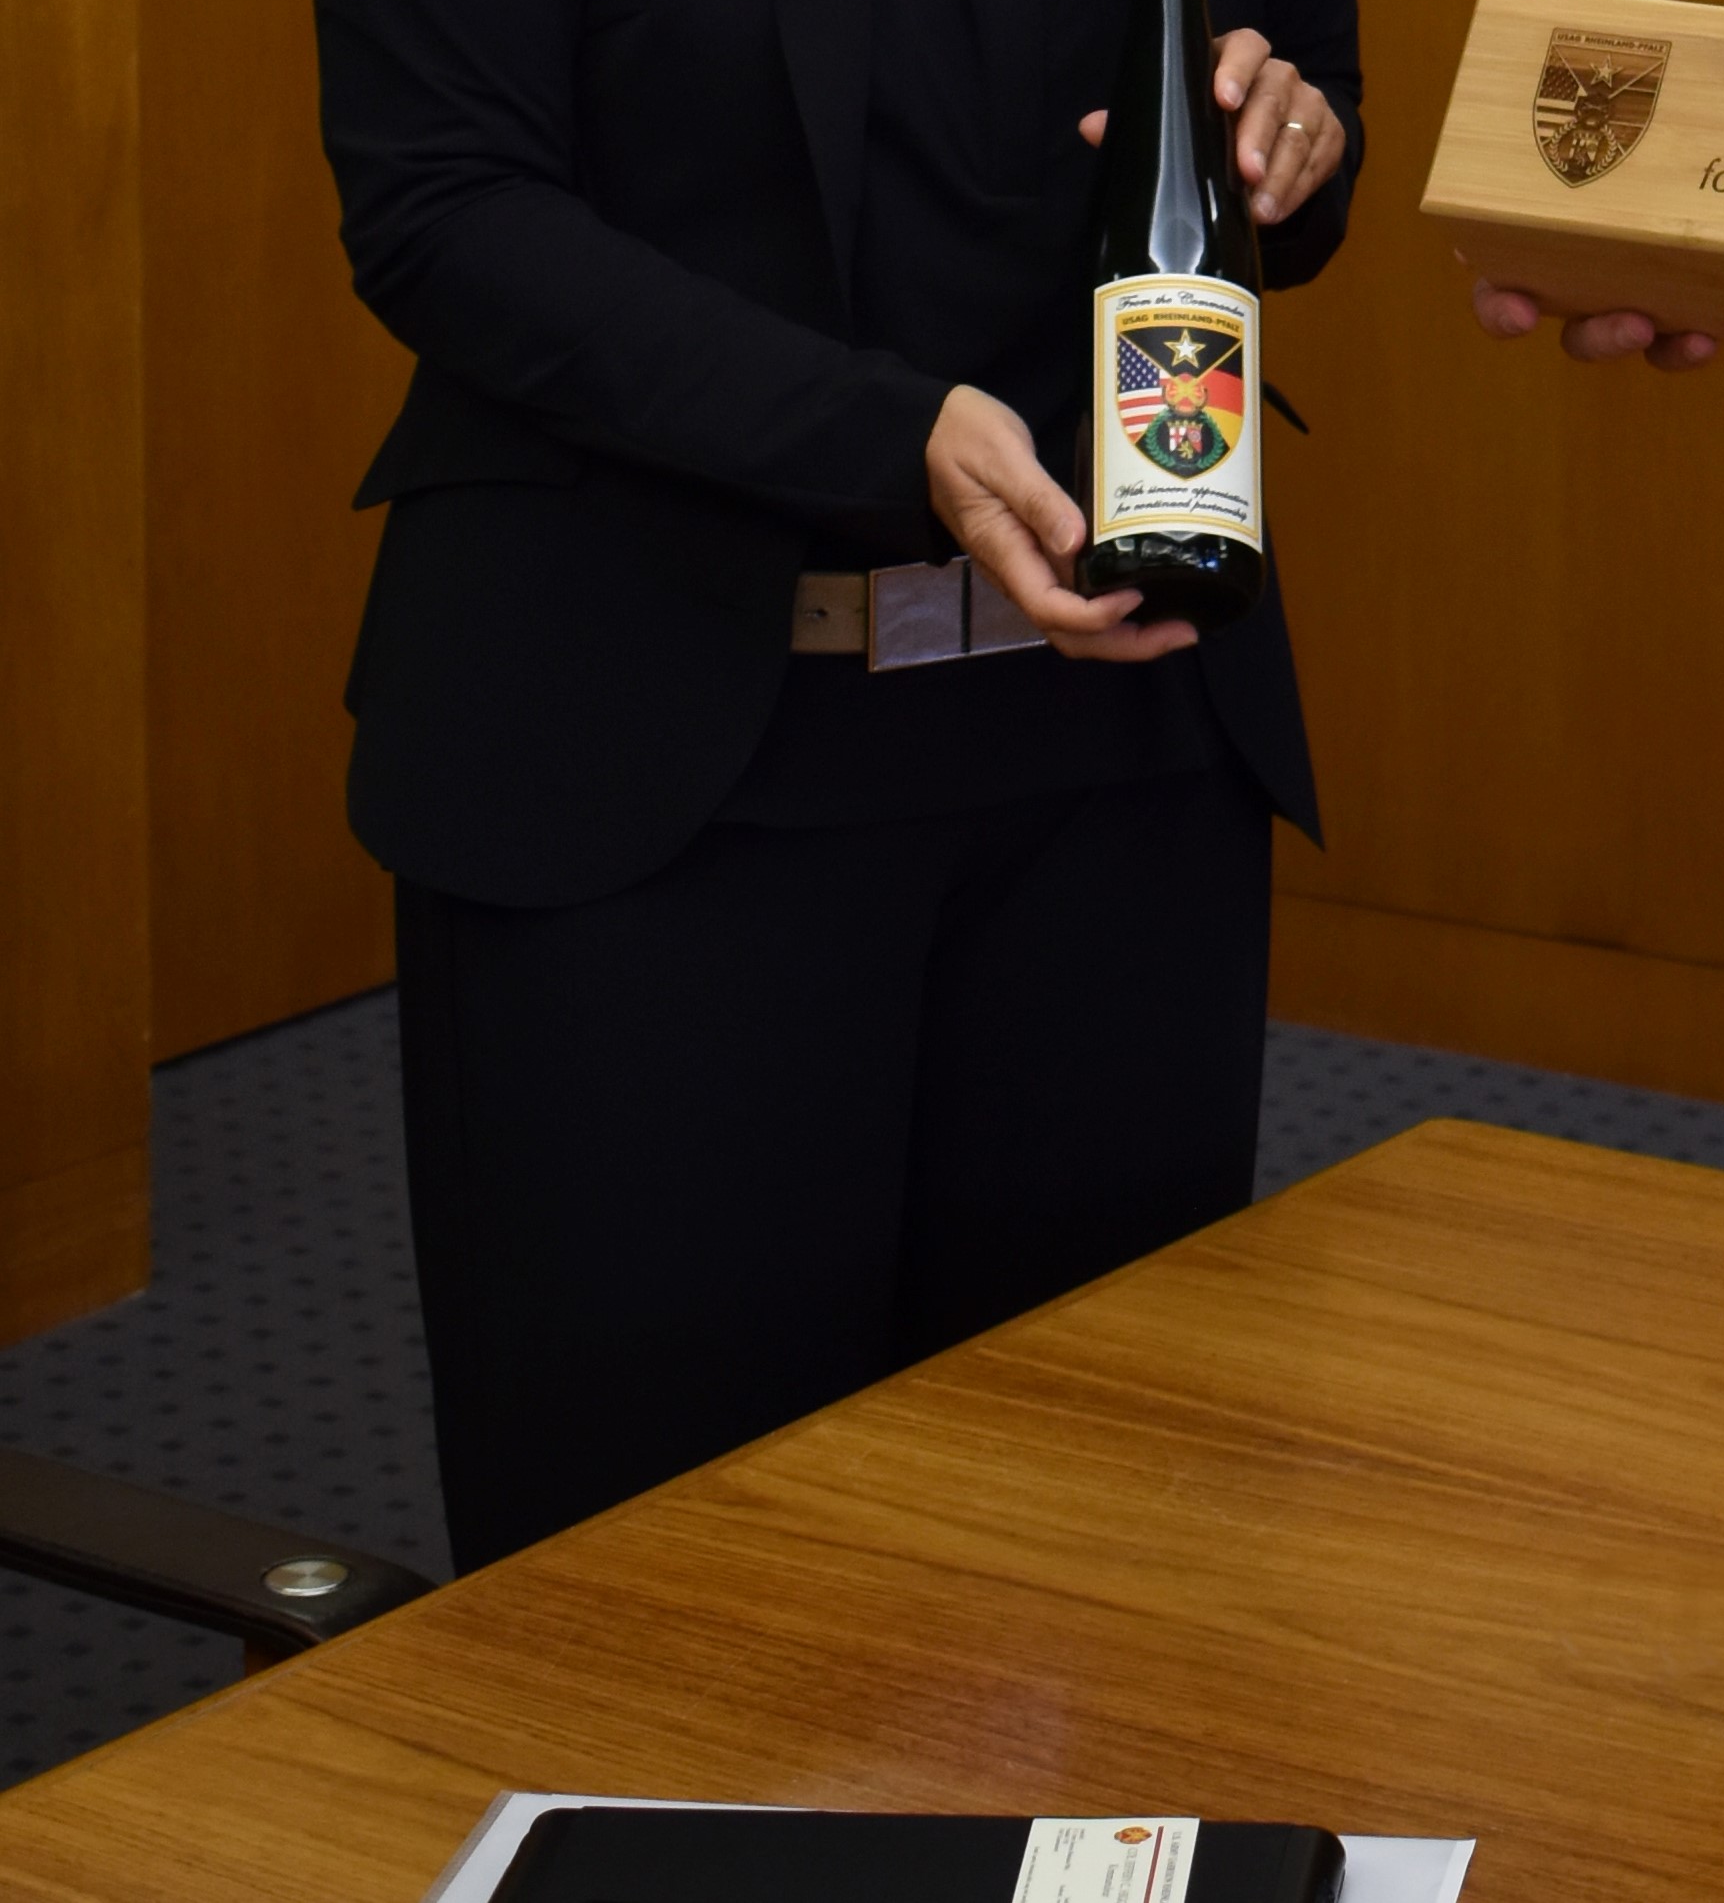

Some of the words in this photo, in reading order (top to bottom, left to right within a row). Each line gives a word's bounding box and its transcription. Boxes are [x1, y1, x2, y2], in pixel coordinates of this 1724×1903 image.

[1116, 294, 1152, 311] From
[1155, 294, 1173, 305] the
[1177, 290, 1245, 317] Commander
[1122, 314, 1149, 325] USAG
